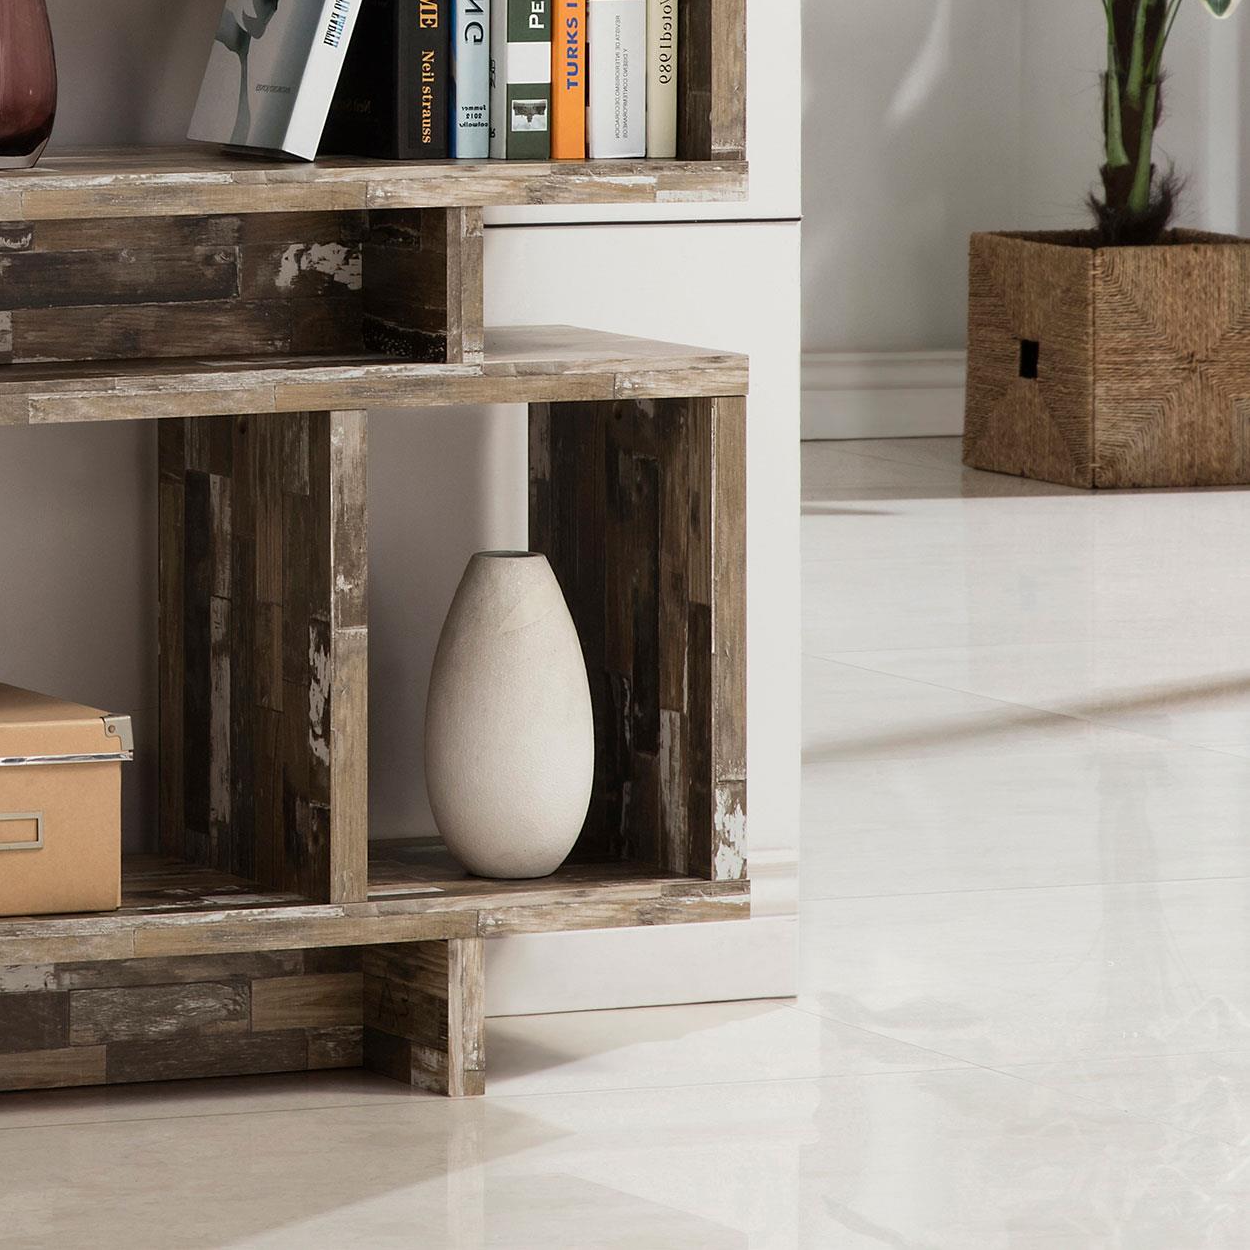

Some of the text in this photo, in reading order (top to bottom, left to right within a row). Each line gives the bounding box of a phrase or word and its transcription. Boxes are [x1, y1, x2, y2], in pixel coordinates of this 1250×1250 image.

[566, 16, 578, 90] TURKS
[421, 51, 435, 144] Neil strauss
